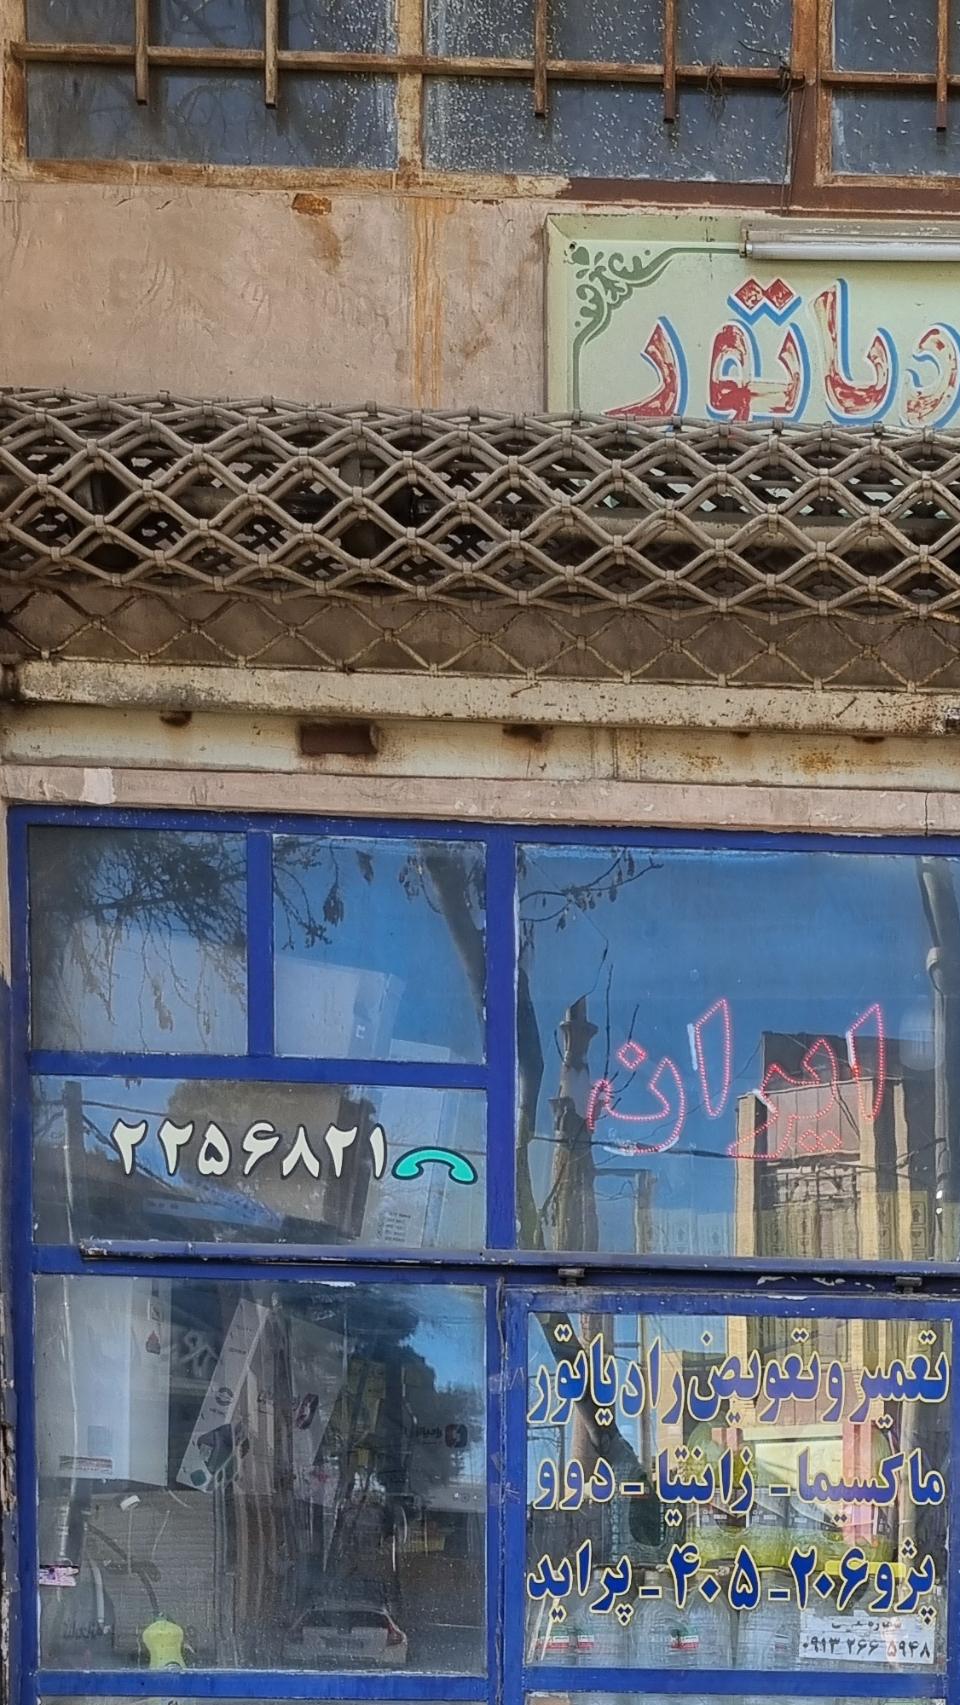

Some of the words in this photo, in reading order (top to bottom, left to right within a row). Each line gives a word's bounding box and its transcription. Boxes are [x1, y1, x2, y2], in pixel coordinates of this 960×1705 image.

[586, 998, 888, 1160] ایران
[110, 1117, 388, 1180] ۲۲۵۶۸۲۱
[526, 1323, 686, 1426] رادیاتور
[687, 1328, 822, 1425] تعویض
[823, 1360, 846, 1424] و
[849, 1329, 950, 1428] تعمیر
[532, 1456, 617, 1511] دوو
[657, 1444, 757, 1528] زانتیا
[797, 1447, 946, 1526] ماکسیما
[526, 1538, 634, 1627] پراید
[667, 1543, 761, 1611] ۴۰۵
[790, 1545, 869, 1610] ۲۰۶
[868, 1536, 937, 1627] پژو
